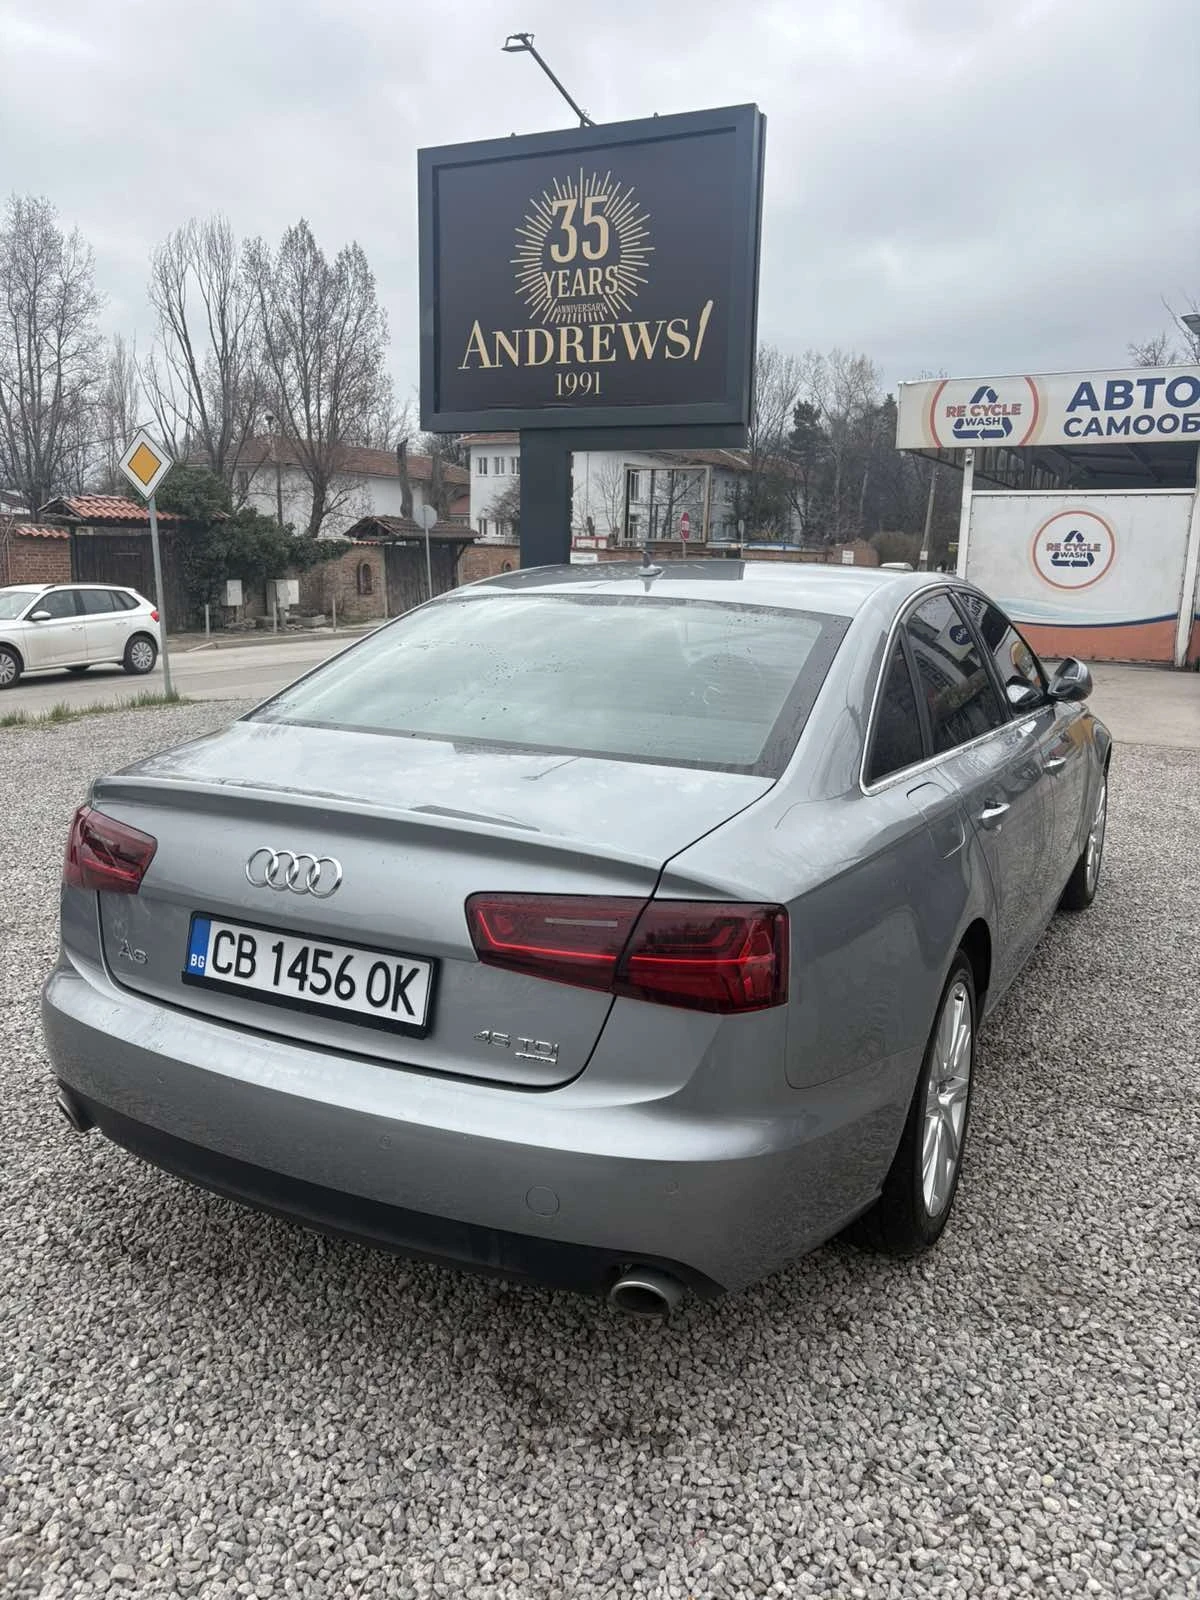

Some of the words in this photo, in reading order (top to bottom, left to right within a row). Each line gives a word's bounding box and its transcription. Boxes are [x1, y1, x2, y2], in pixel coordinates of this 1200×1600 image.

[551, 195, 609, 264] 35
[542, 265, 619, 299] YEARS
[556, 303, 605, 313] ANNIVERSARY
[555, 371, 603, 396] 1991
[1066, 376, 1200, 412] АВТО
[946, 405, 967, 417] RE
[970, 403, 1022, 417] CYCLE
[965, 417, 1001, 426] WASH
[1046, 543, 1061, 552] RE
[1064, 543, 1101, 552] CYCLE
[190, 953, 205, 968] BG
[211, 929, 257, 979] CB
[271, 940, 356, 1000] 1456
[365, 960, 420, 1016] OK
[517, 1037, 559, 1055] TDI
